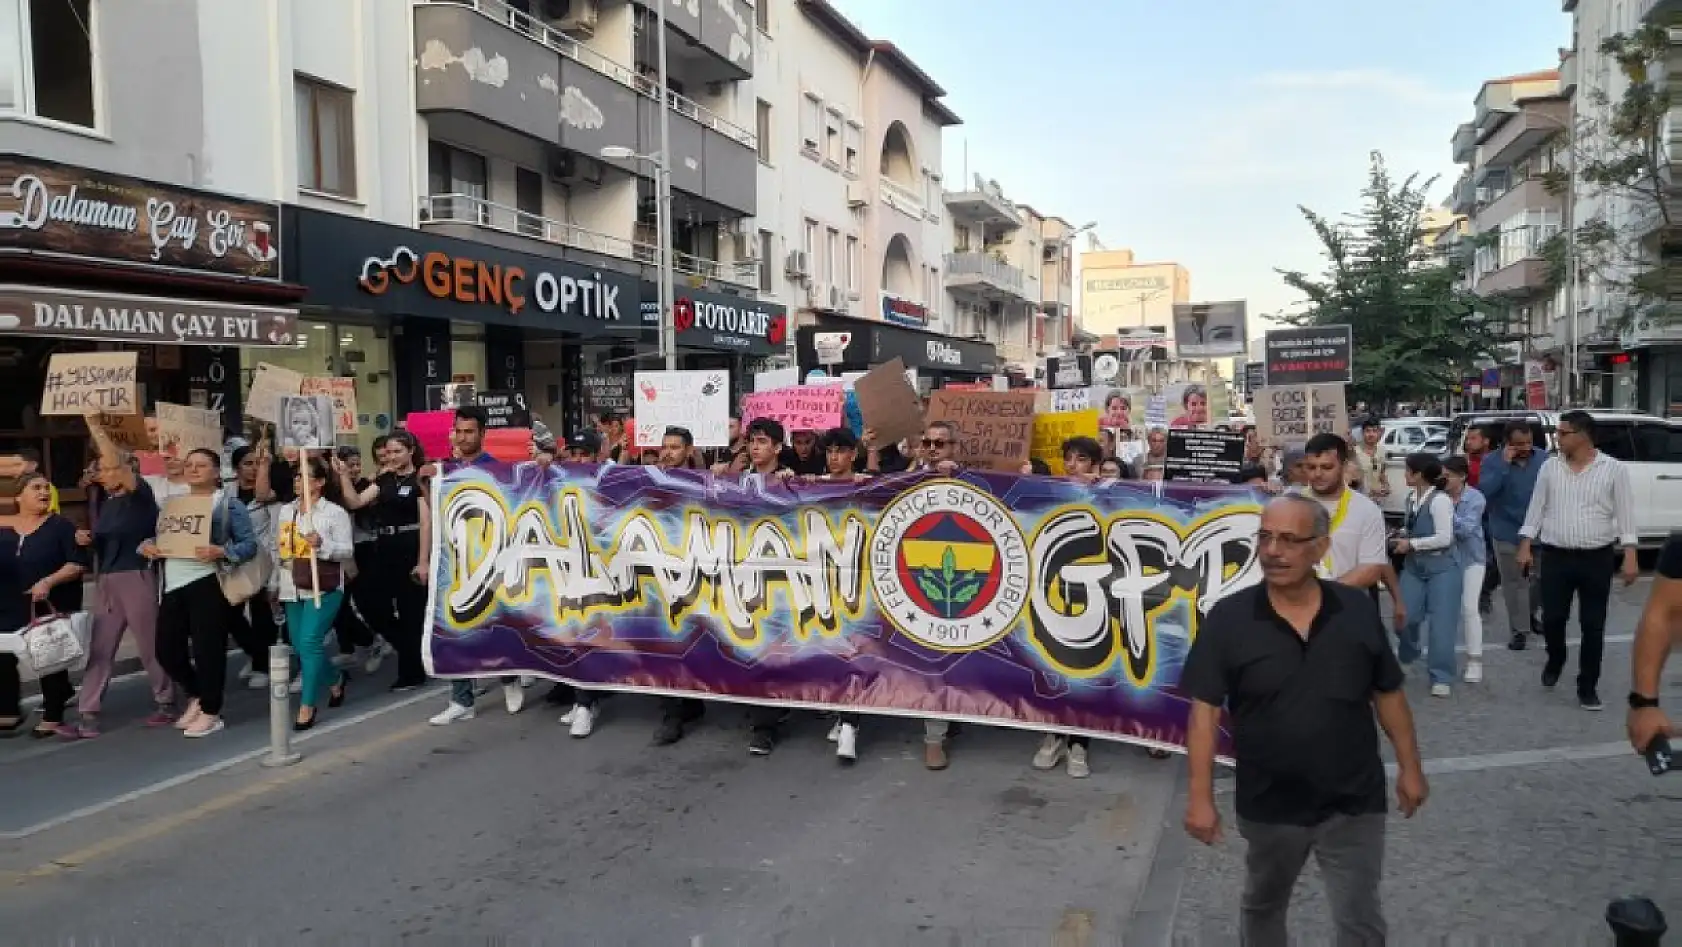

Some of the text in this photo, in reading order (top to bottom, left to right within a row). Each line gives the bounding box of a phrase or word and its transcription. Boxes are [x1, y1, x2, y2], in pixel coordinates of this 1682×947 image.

[13, 174, 246, 260] Dalaman Çay Evi
[423, 252, 621, 320] GENÇ OPTİK
[34, 302, 258, 342] DALAMAN ÇAY EVİ
[694, 301, 769, 336] FOTO ARİF
[52, 387, 130, 411] HAKTIR
[445, 487, 866, 640] DALAMAN
[875, 490, 940, 609] FENERBAHÇE
[947, 489, 1003, 530] SPOR
[928, 621, 970, 641] 1907
